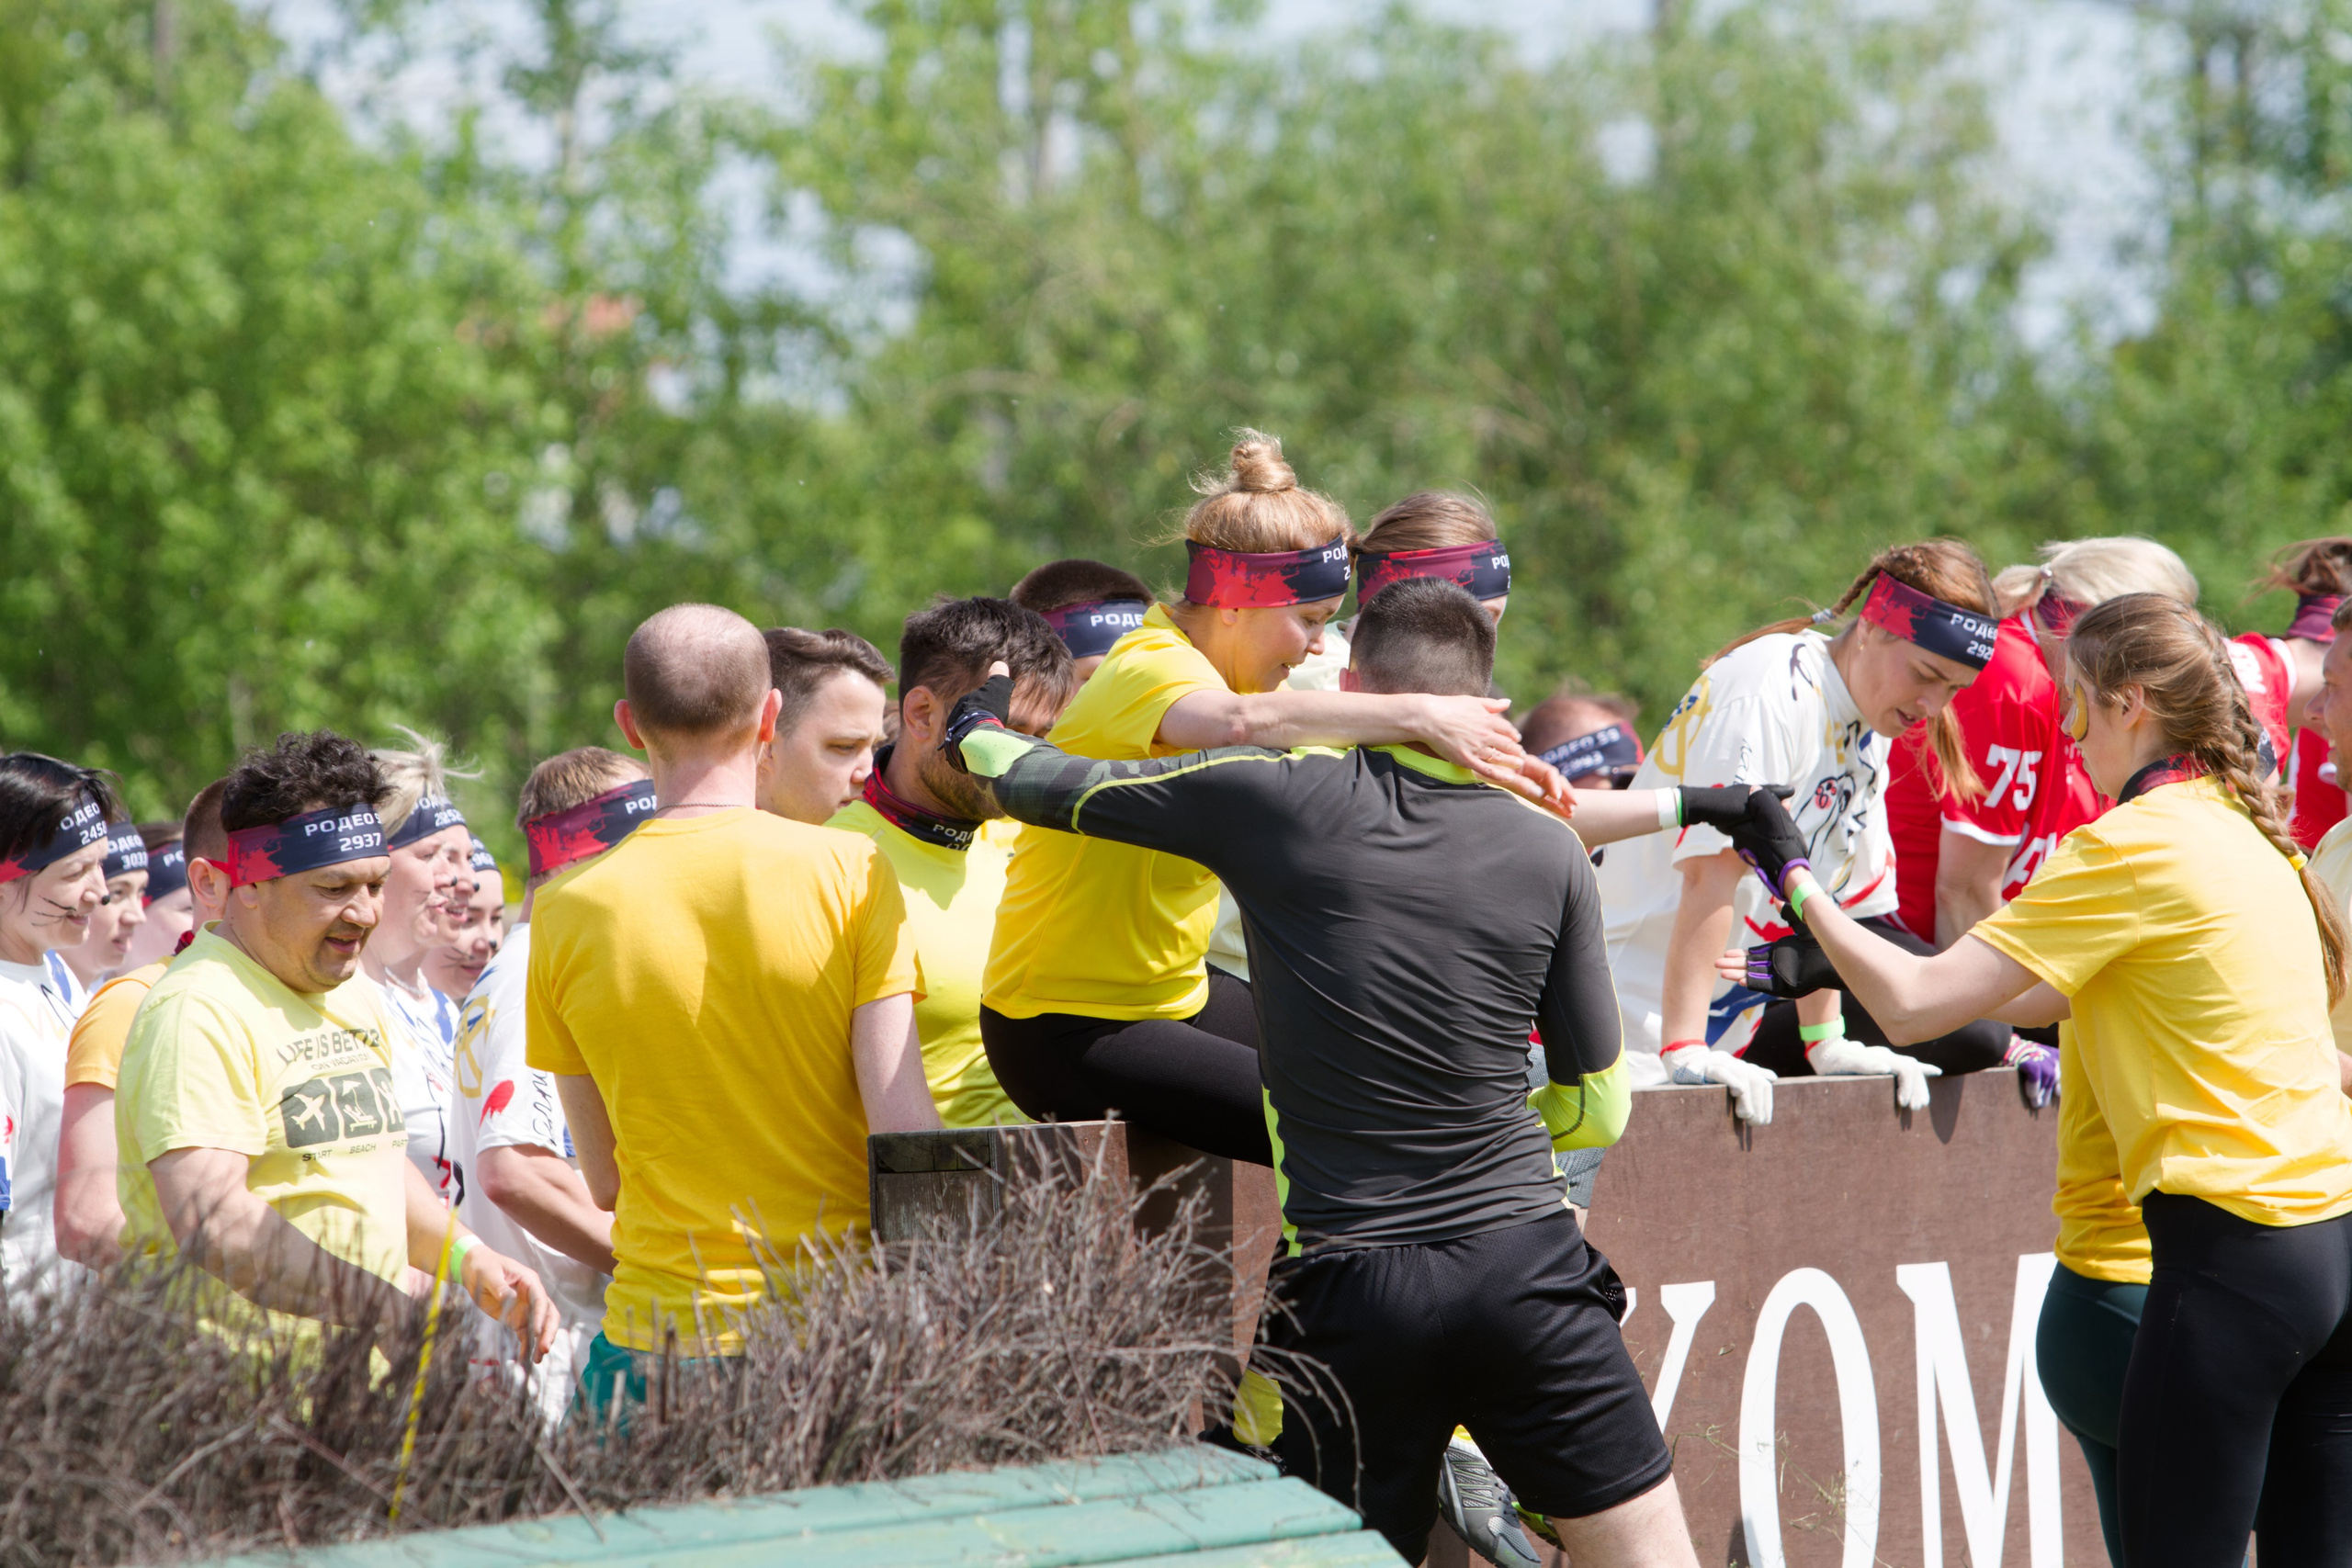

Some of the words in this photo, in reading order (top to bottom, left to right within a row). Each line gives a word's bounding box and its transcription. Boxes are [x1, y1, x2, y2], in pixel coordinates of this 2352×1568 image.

[1984, 743, 2042, 811] 75
[60, 802, 100, 830] ОДЕО
[304, 812, 375, 837] РОДЕО
[338, 832, 381, 852] 2937
[277, 1038, 313, 1066] LIFE
[316, 1033, 329, 1058] IS
[302, 1149, 333, 1162] START
[349, 1143, 377, 1155] BEACH
